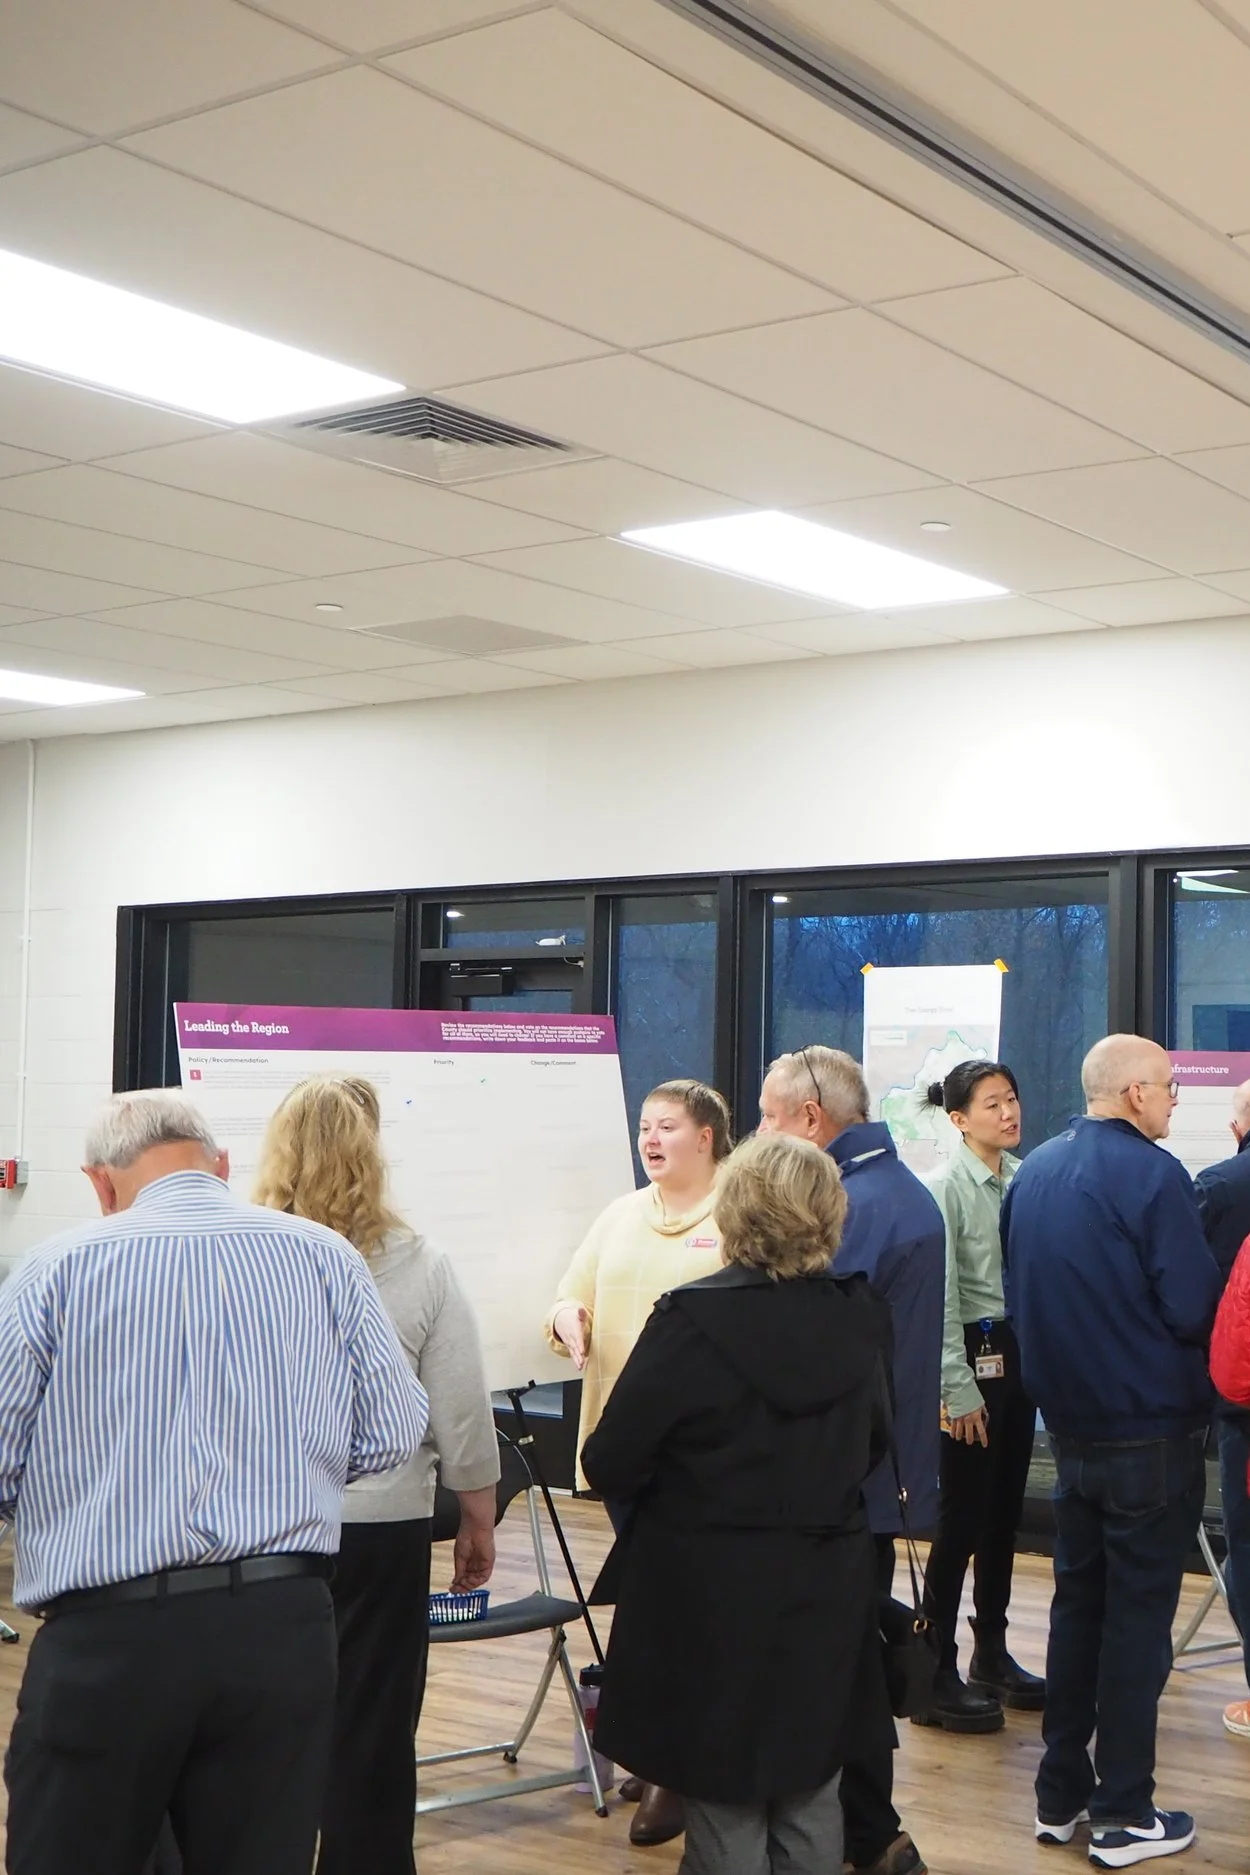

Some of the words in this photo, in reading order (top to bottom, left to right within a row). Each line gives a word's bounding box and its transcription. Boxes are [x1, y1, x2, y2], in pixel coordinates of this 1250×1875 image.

[184, 1020, 230, 1036] Leading
[231, 1021, 250, 1033] the
[251, 1022, 290, 1036] Region
